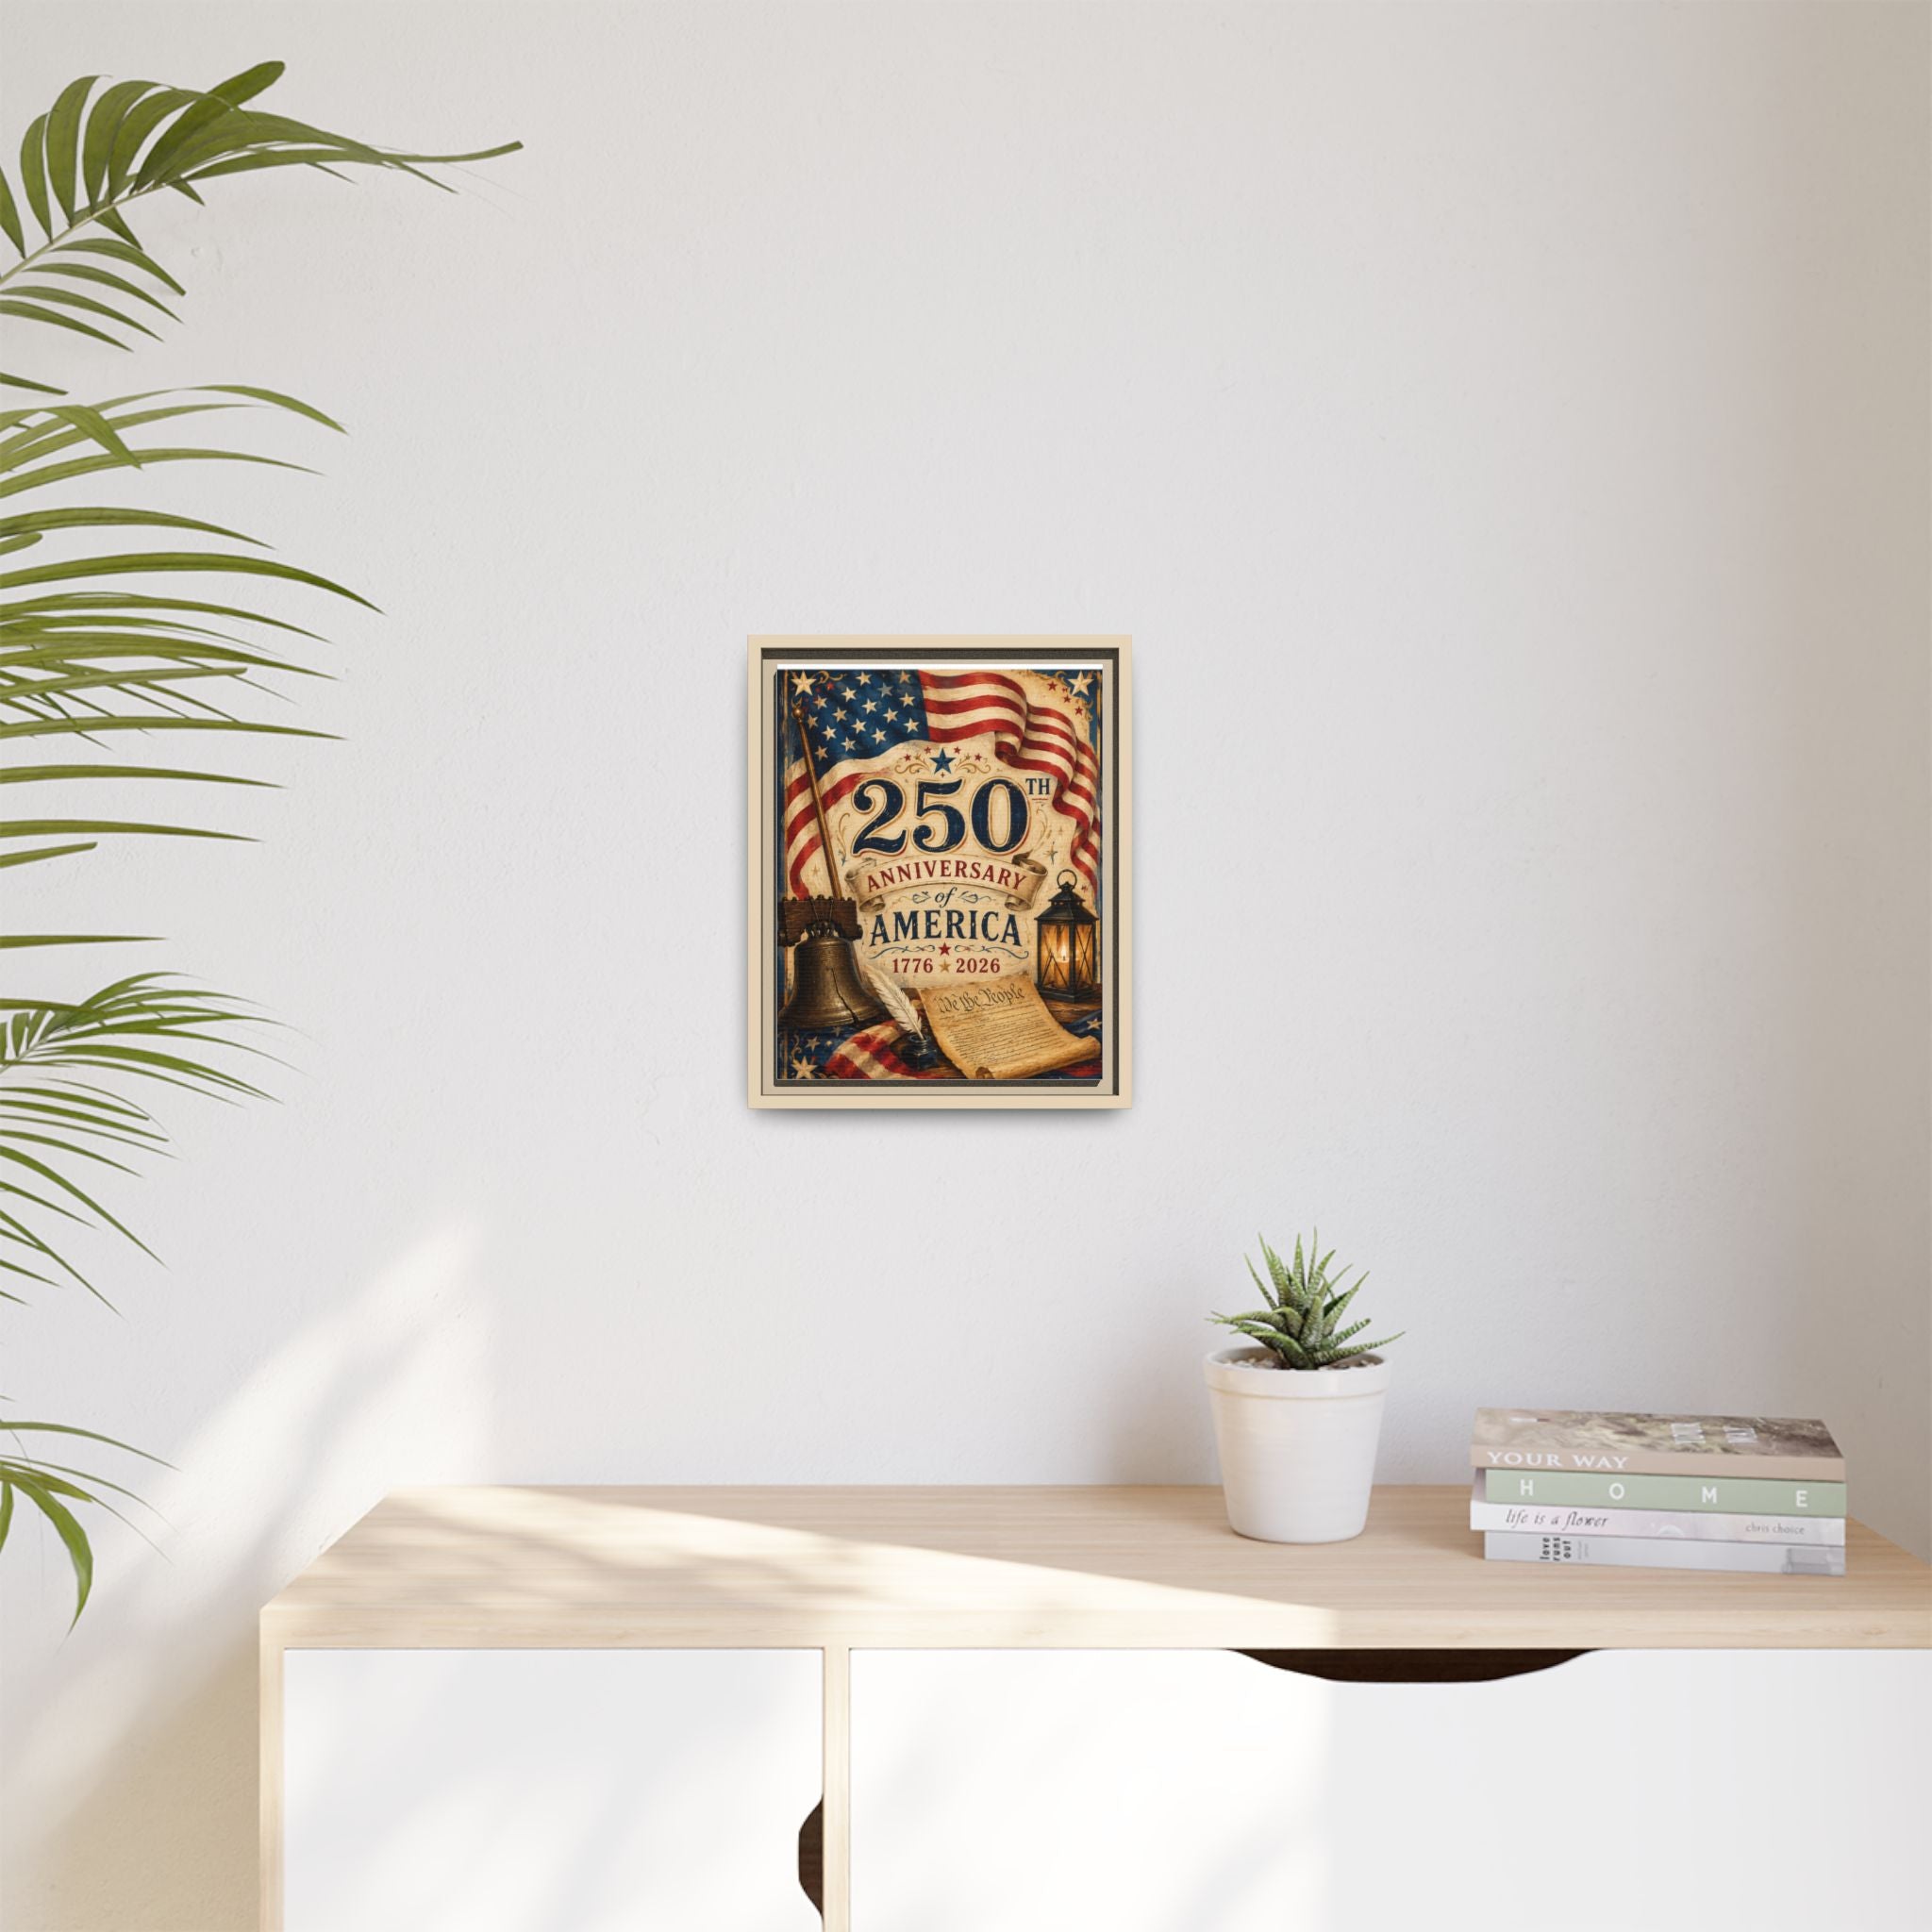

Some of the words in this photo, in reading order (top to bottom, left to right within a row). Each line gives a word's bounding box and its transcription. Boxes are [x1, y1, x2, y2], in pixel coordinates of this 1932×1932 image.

[867, 859, 1027, 892] ANNIVERSARY
[935, 887, 958, 908] of
[869, 909, 1022, 947] AMERICA
[892, 958, 934, 974] 1776
[956, 958, 1001, 974] 2026
[934, 995, 958, 1013] We
[978, 983, 1025, 1008] People
[1487, 1451, 1562, 1467] YOUR
[1572, 1454, 1629, 1469] WAY
[1506, 1508, 1529, 1528] life
[1534, 1511, 1546, 1525] is
[1550, 1514, 1560, 1525] a
[1561, 1510, 1609, 1531] flower
[1745, 1522, 1770, 1533] chris
[1772, 1523, 1806, 1535] choice
[1540, 1537, 1550, 1559] love
[1553, 1537, 1561, 1561] runs
[1562, 1541, 1571, 1558] out
